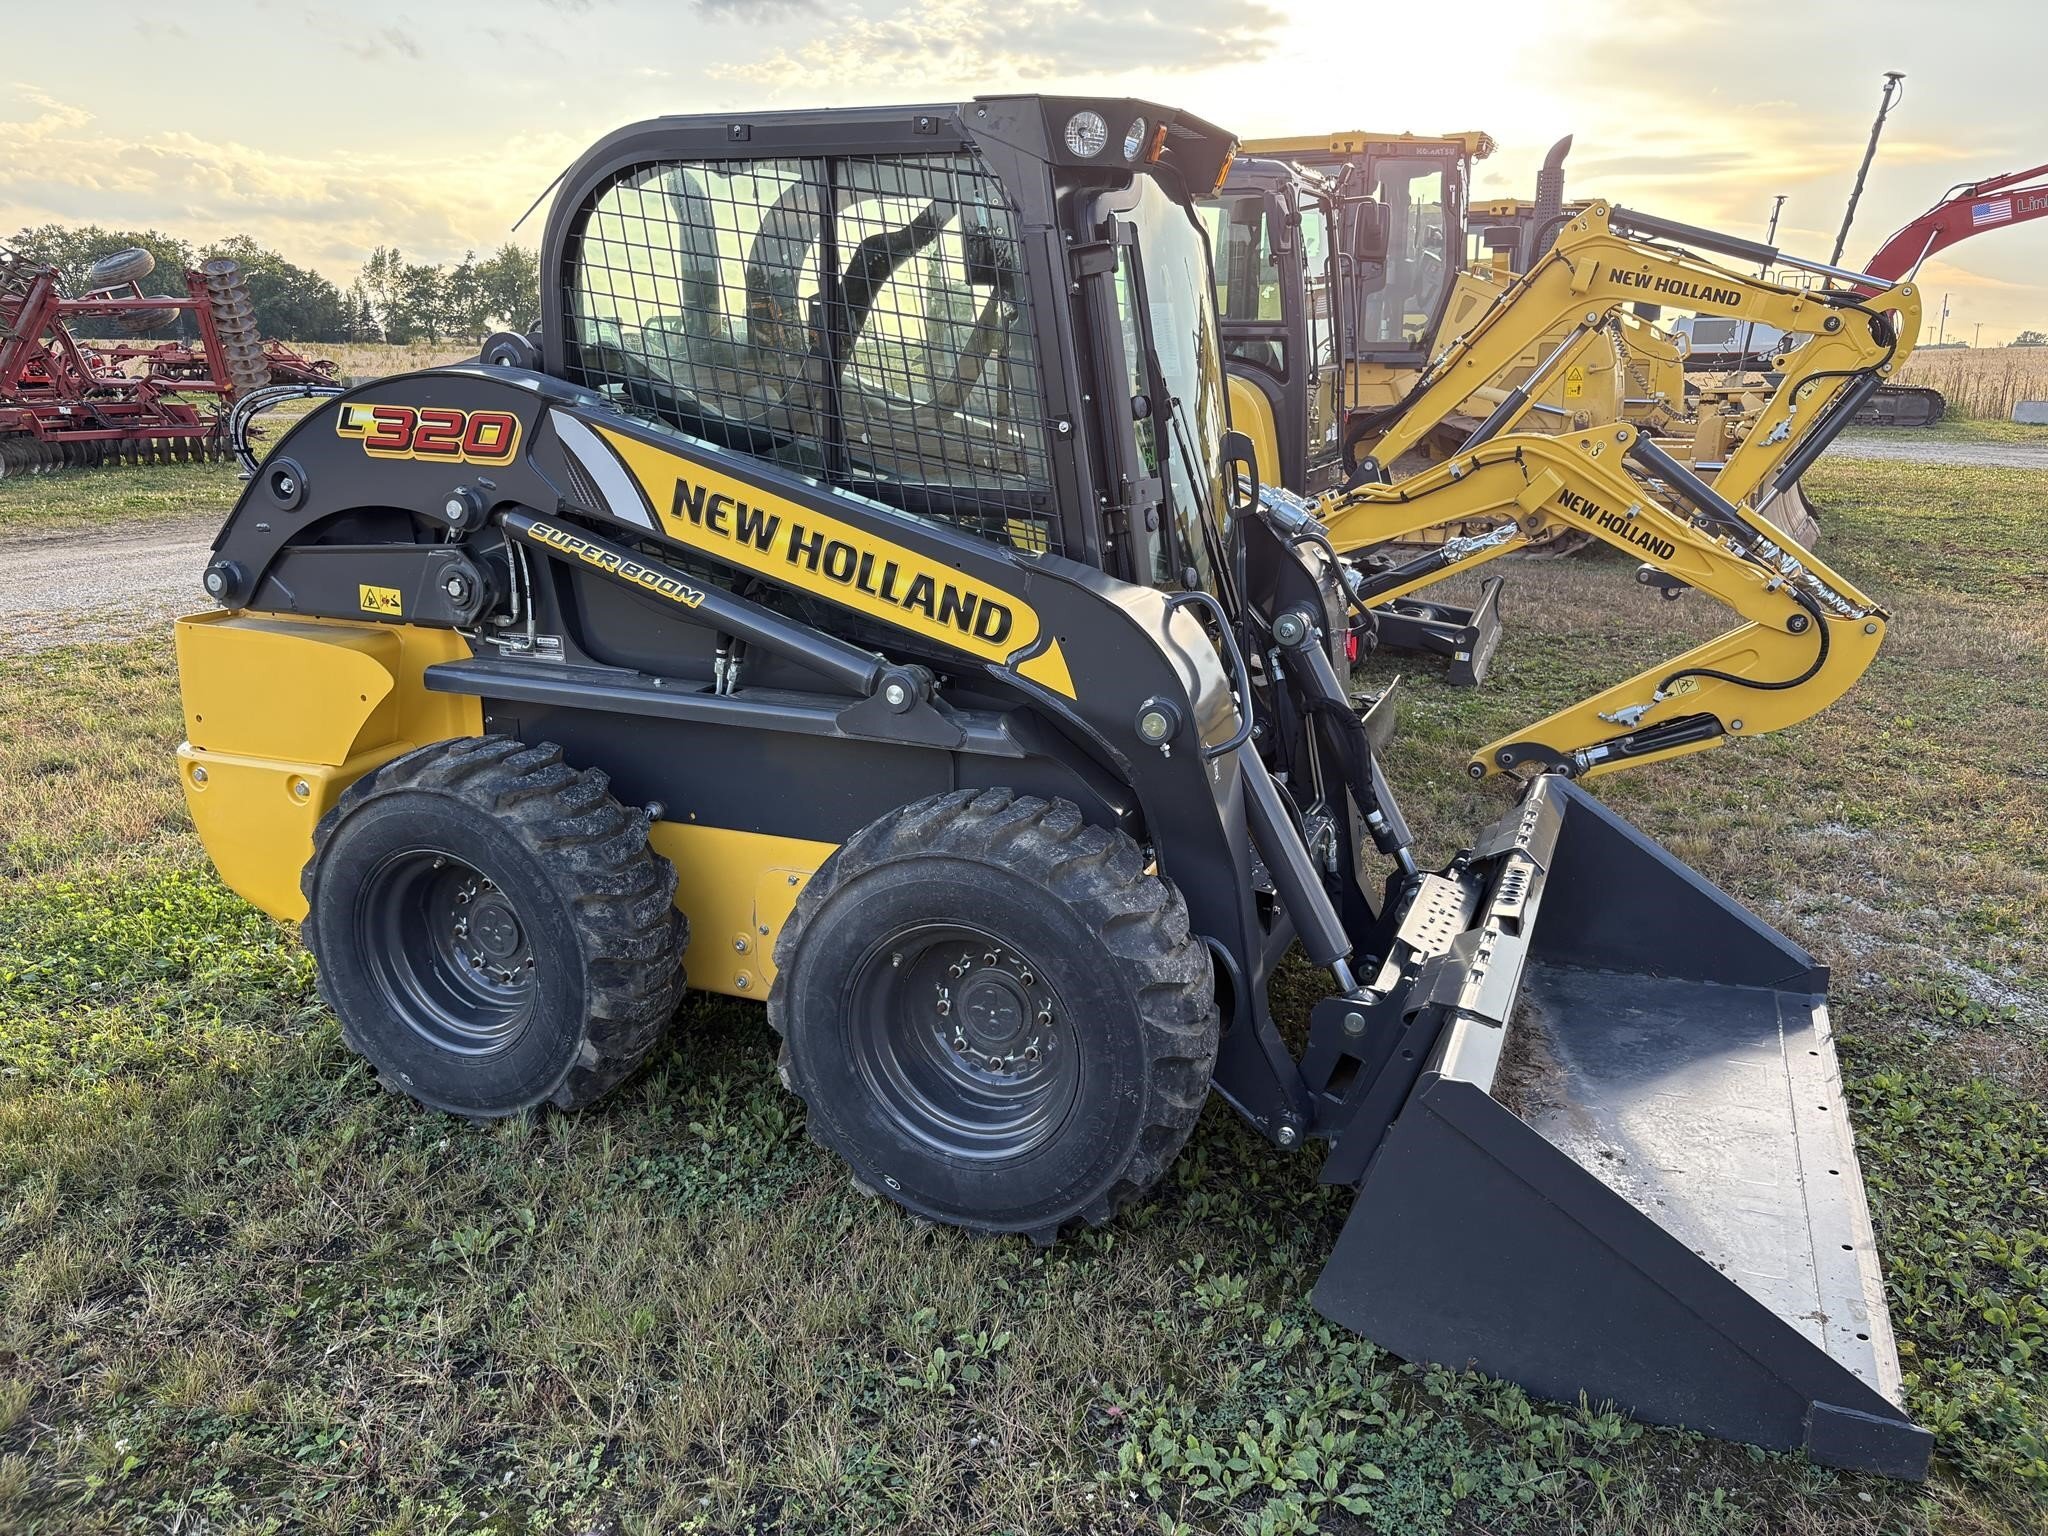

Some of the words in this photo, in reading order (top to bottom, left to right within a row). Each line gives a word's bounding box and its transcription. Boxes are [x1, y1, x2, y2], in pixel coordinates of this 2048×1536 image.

[1609, 268, 1653, 289] NEW
[1654, 277, 1741, 306] HOLLAND
[336, 403, 522, 466] L320
[1557, 488, 1600, 520] NEW
[1597, 509, 1675, 561] HOLLAND
[528, 520, 622, 572] SUPER
[618, 559, 706, 608] BOOM
[670, 477, 781, 553] NEW
[785, 522, 1014, 646] HOLLAND
